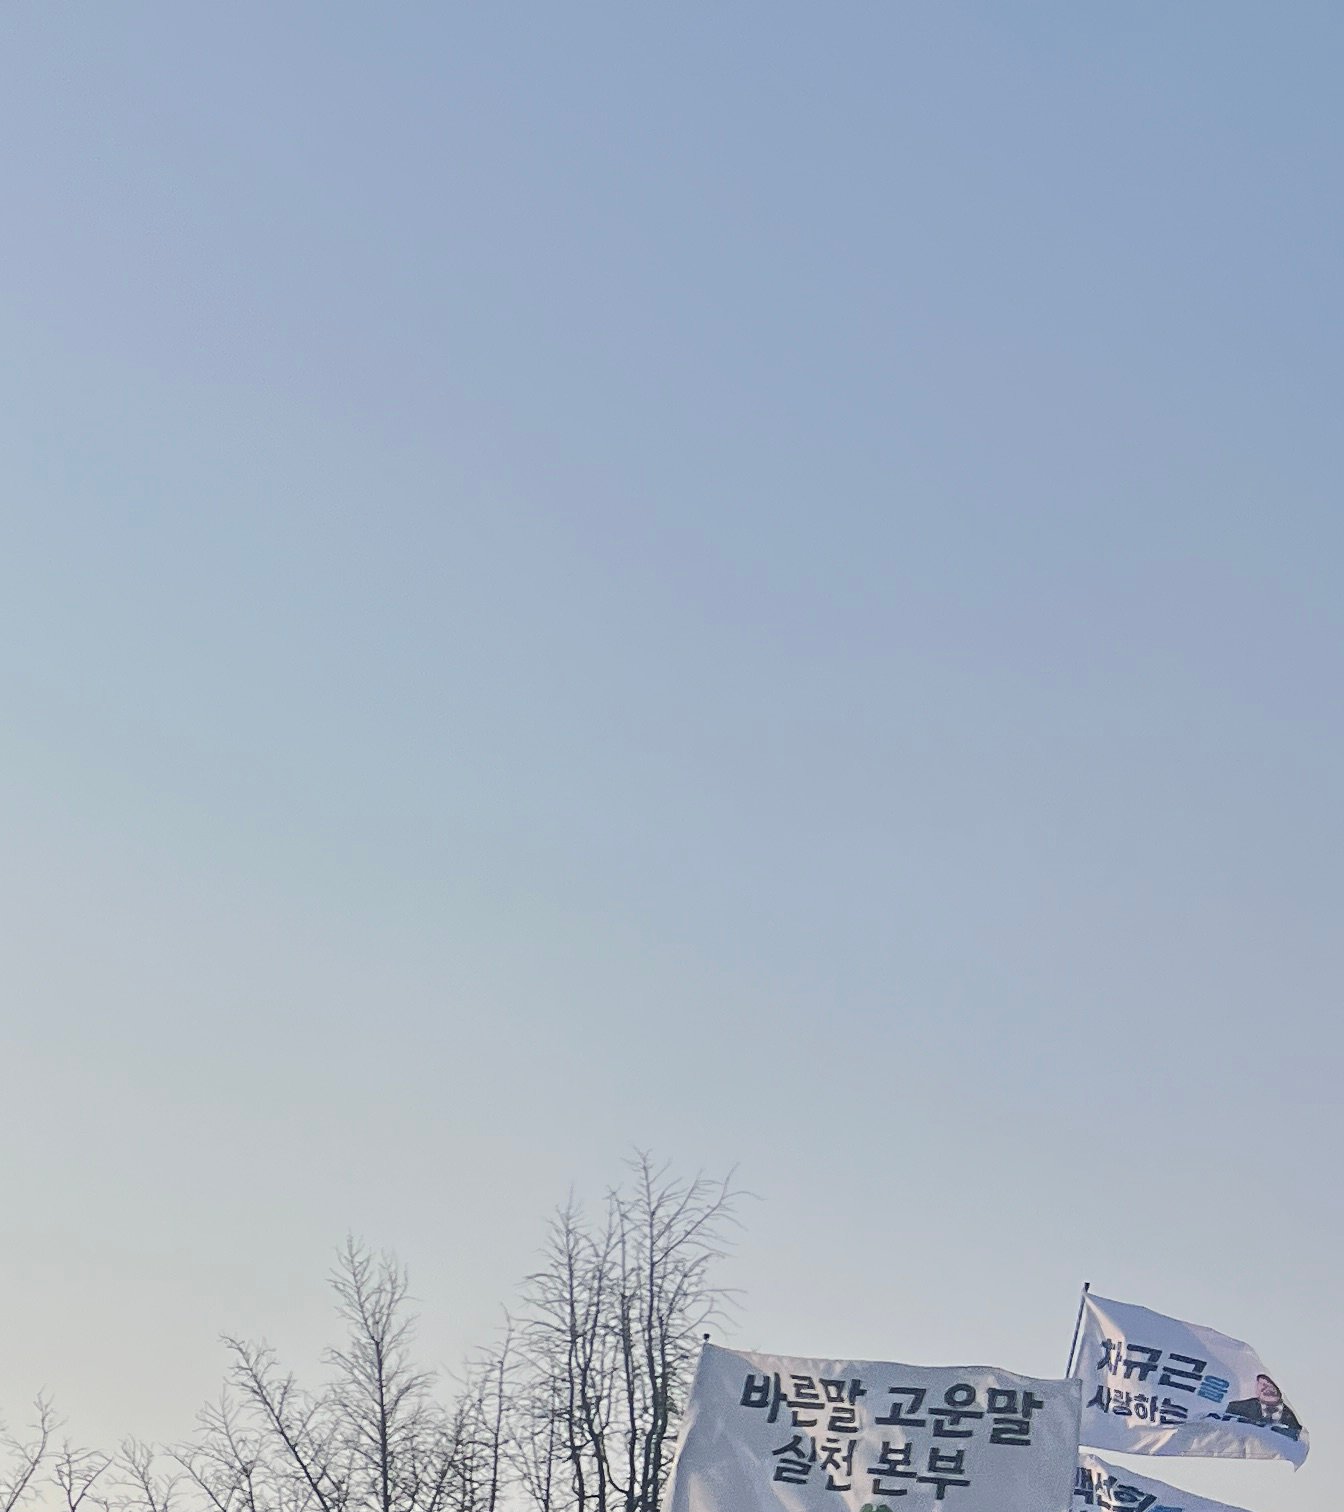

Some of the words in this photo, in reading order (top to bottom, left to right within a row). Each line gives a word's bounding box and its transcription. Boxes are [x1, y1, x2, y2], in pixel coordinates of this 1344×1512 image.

[740, 1372, 868, 1434] 바른말
[875, 1382, 1043, 1446] 고운말
[1087, 1385, 1188, 1425] 사랑하는
[771, 1434, 856, 1493] 실천
[867, 1444, 970, 1501] 본부
